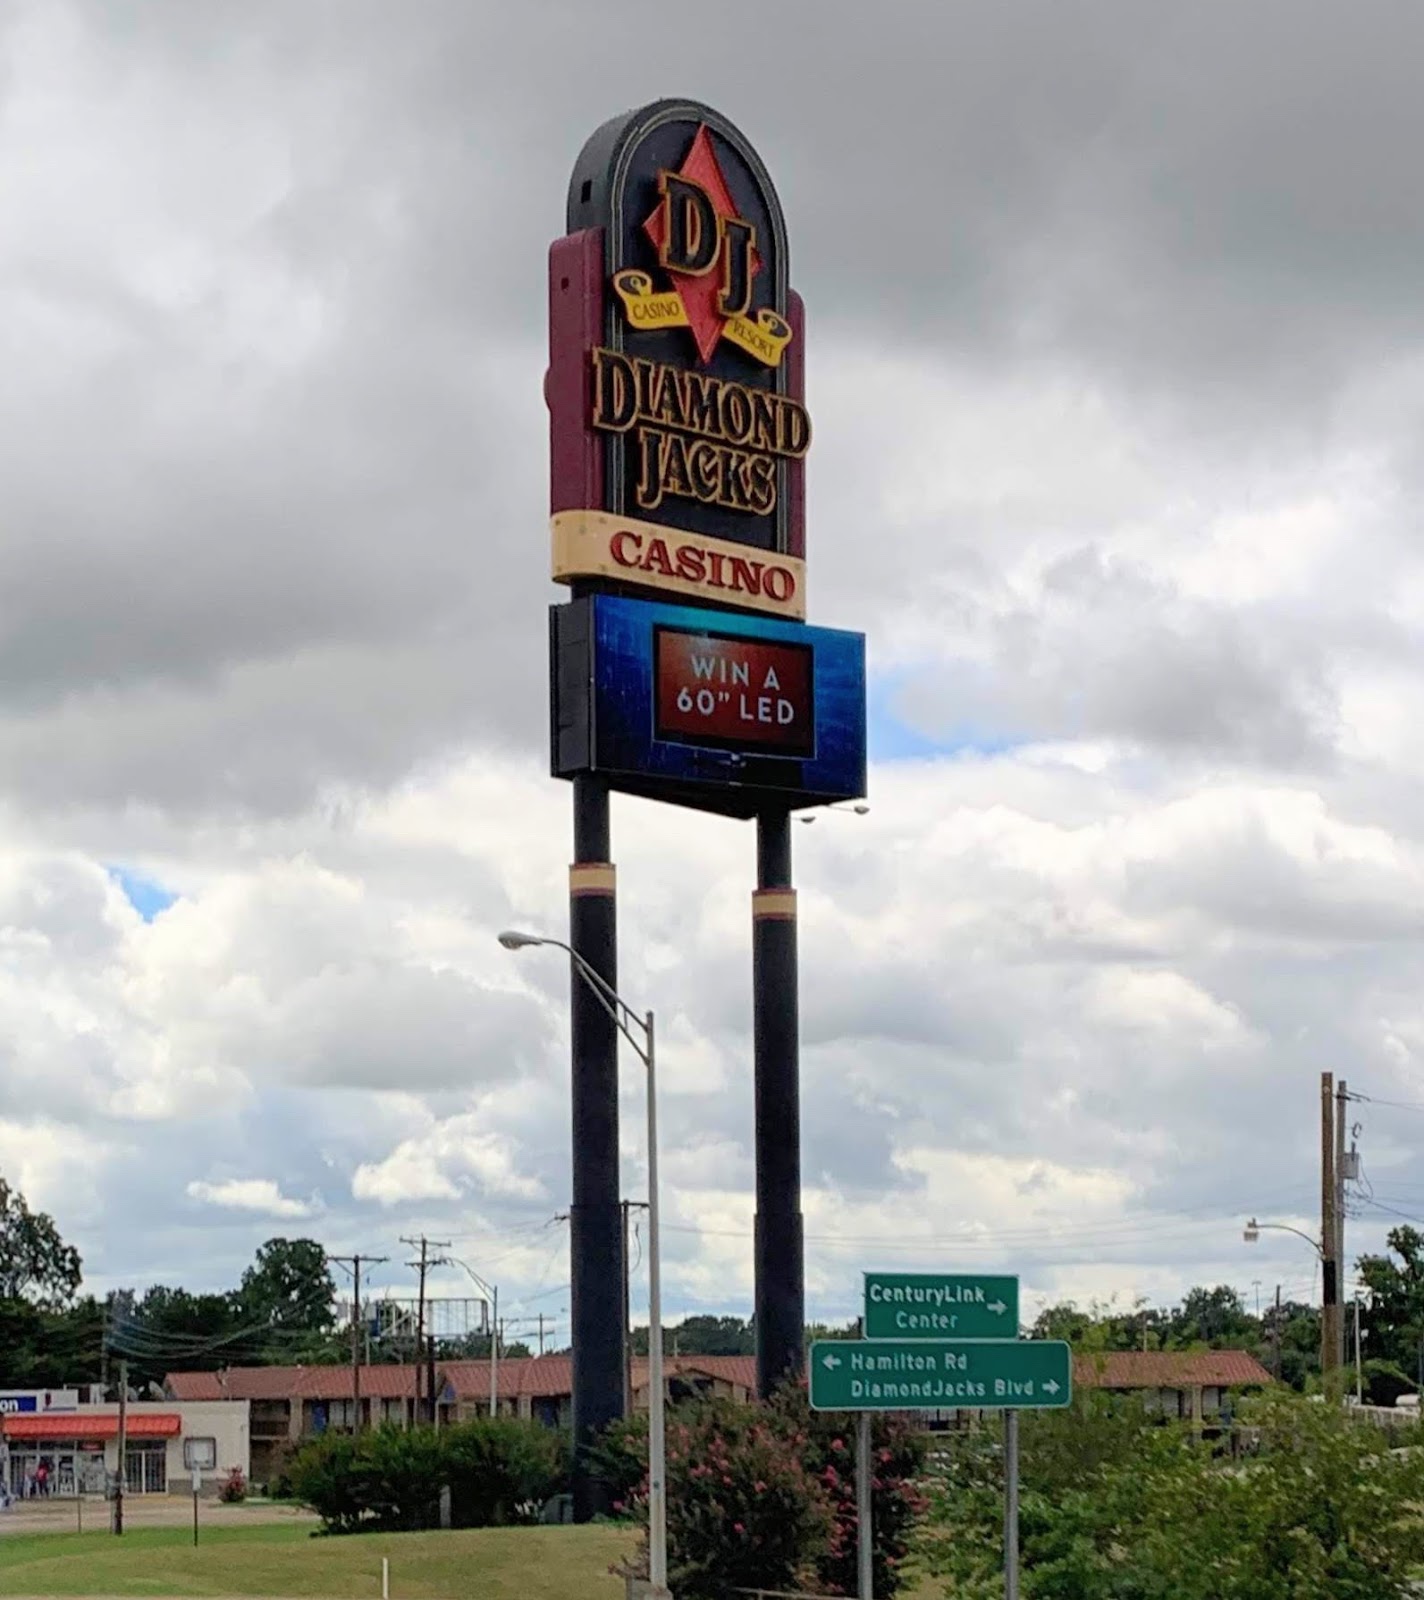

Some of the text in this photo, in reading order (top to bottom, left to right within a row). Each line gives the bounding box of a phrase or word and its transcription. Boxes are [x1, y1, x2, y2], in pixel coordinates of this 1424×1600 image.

[659, 171, 756, 316] DJ
[632, 301, 681, 320] CASINO
[733, 320, 775, 358] RESORT
[593, 348, 812, 457] DIAMOND
[638, 426, 776, 515] JACKS
[610, 531, 795, 601] CASINO
[691, 655, 781, 691] WIN A
[740, 693, 795, 725] LED
[869, 1283, 986, 1307] CenturyLink
[896, 1312, 959, 1329] Center
[851, 1353, 968, 1371] Hamilton Rd
[851, 1379, 1034, 1398] DiamondJacks Blvd
